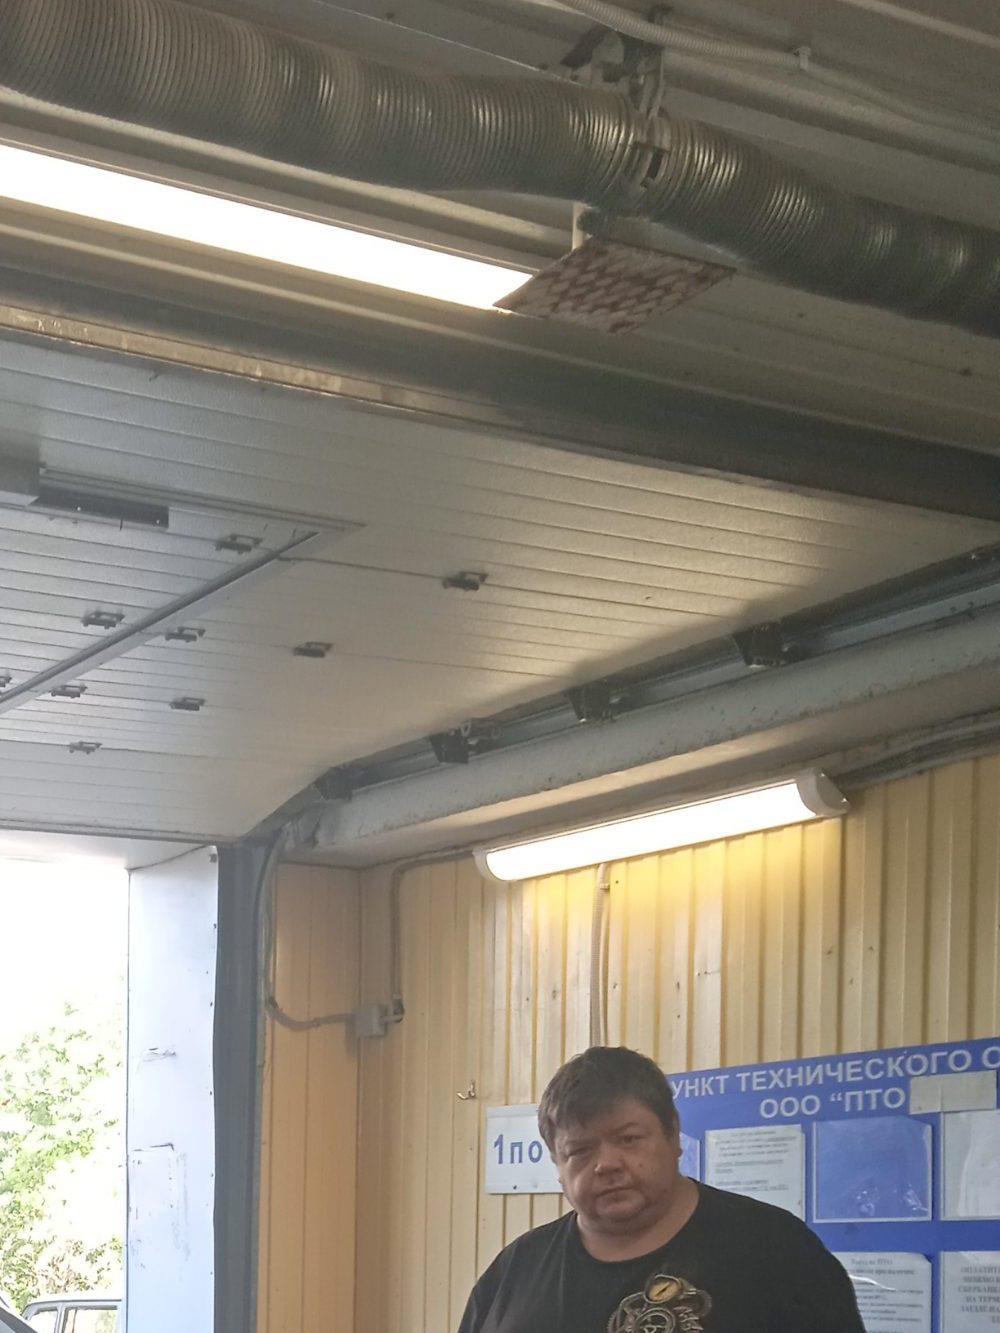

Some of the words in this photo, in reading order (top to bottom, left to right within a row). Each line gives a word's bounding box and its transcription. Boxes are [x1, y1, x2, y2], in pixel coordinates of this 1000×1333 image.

[671, 1074, 730, 1099] УНКТ
[736, 1049, 972, 1092] ТЕХНИЧЕСКОГО
[982, 1045, 1000, 1070] О
[760, 1095, 820, 1119] ООО
